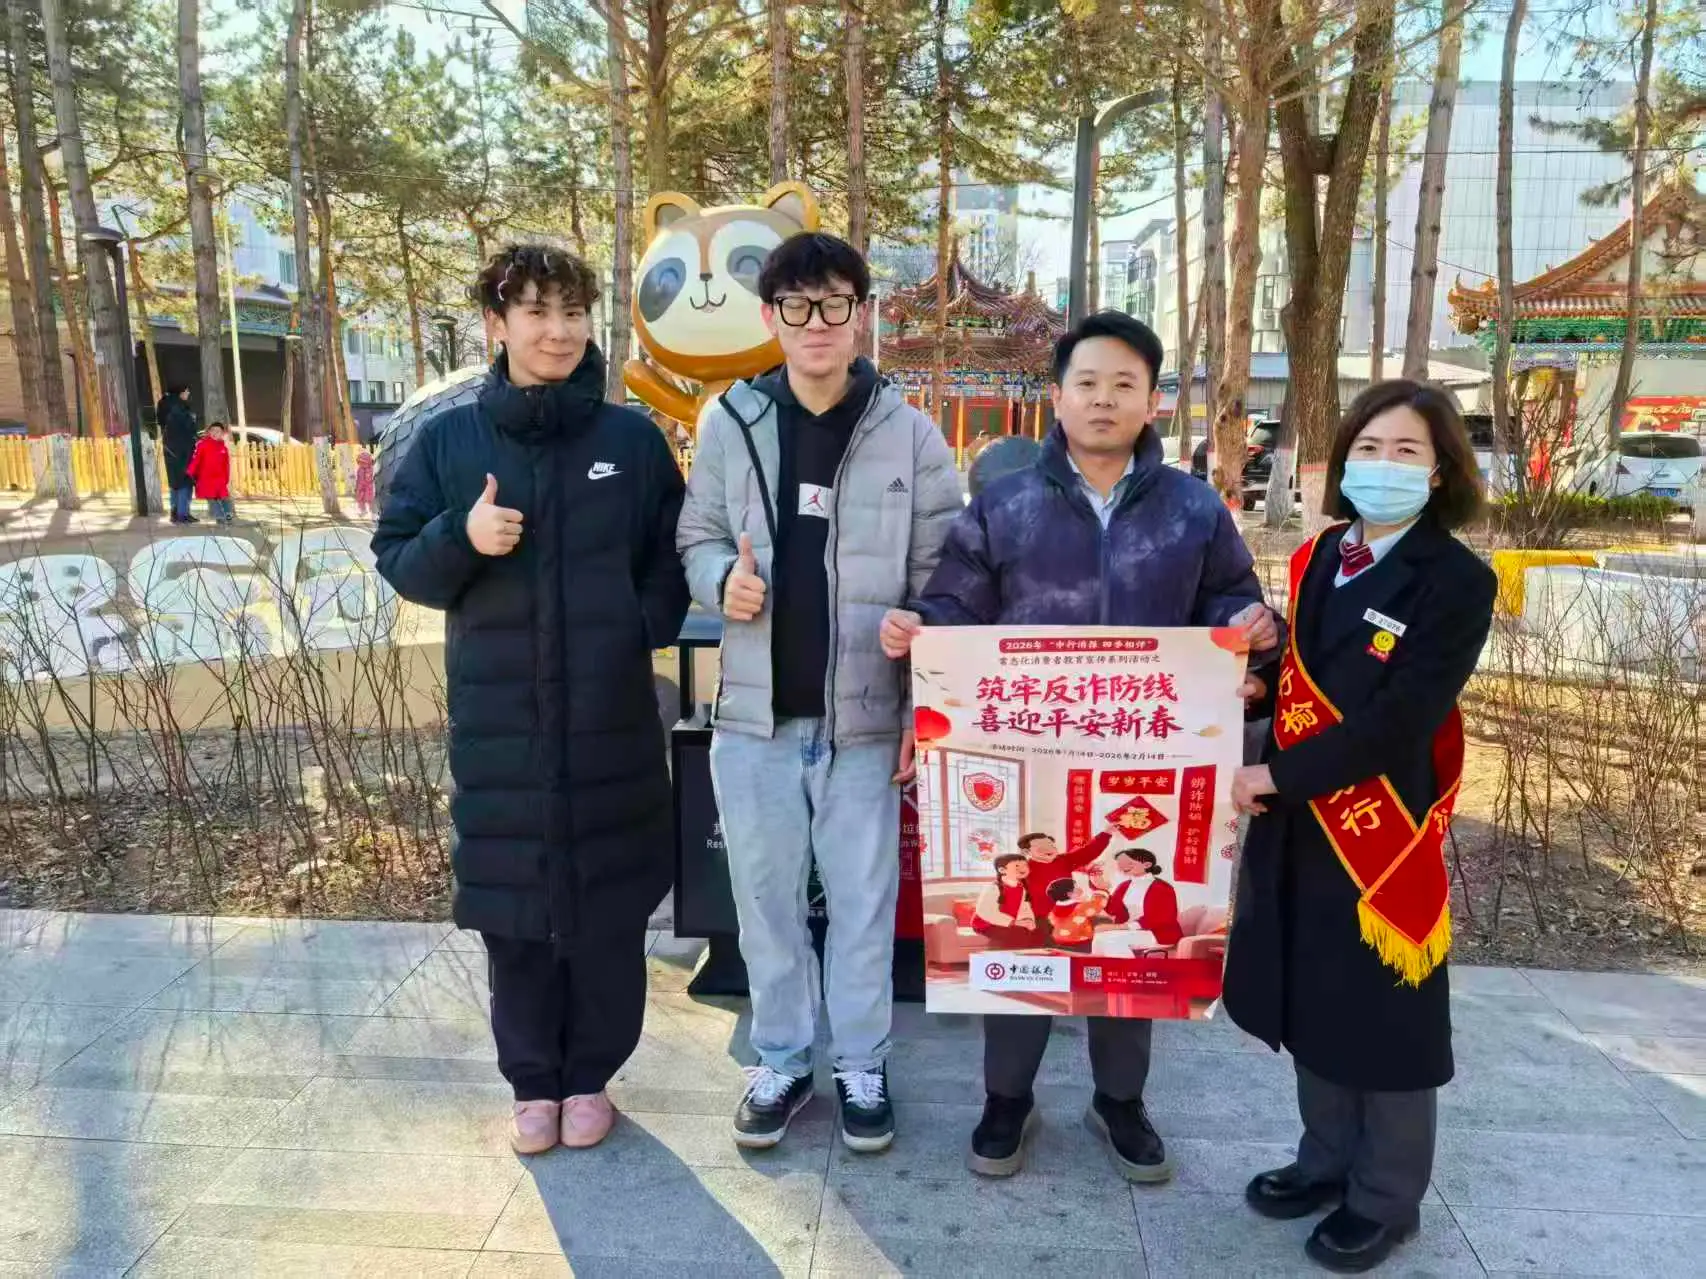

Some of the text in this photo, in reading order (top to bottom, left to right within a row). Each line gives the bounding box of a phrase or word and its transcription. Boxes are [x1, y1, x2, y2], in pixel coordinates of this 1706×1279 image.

[593, 461, 616, 473] NIKE
[975, 672, 1179, 705] 筑牢反诈防线
[971, 704, 1185, 739] 喜迎平安新春
[1107, 775, 1169, 789] 岁岁平安
[1117, 806, 1152, 830] 福
[1009, 963, 1055, 976] 中国银行
